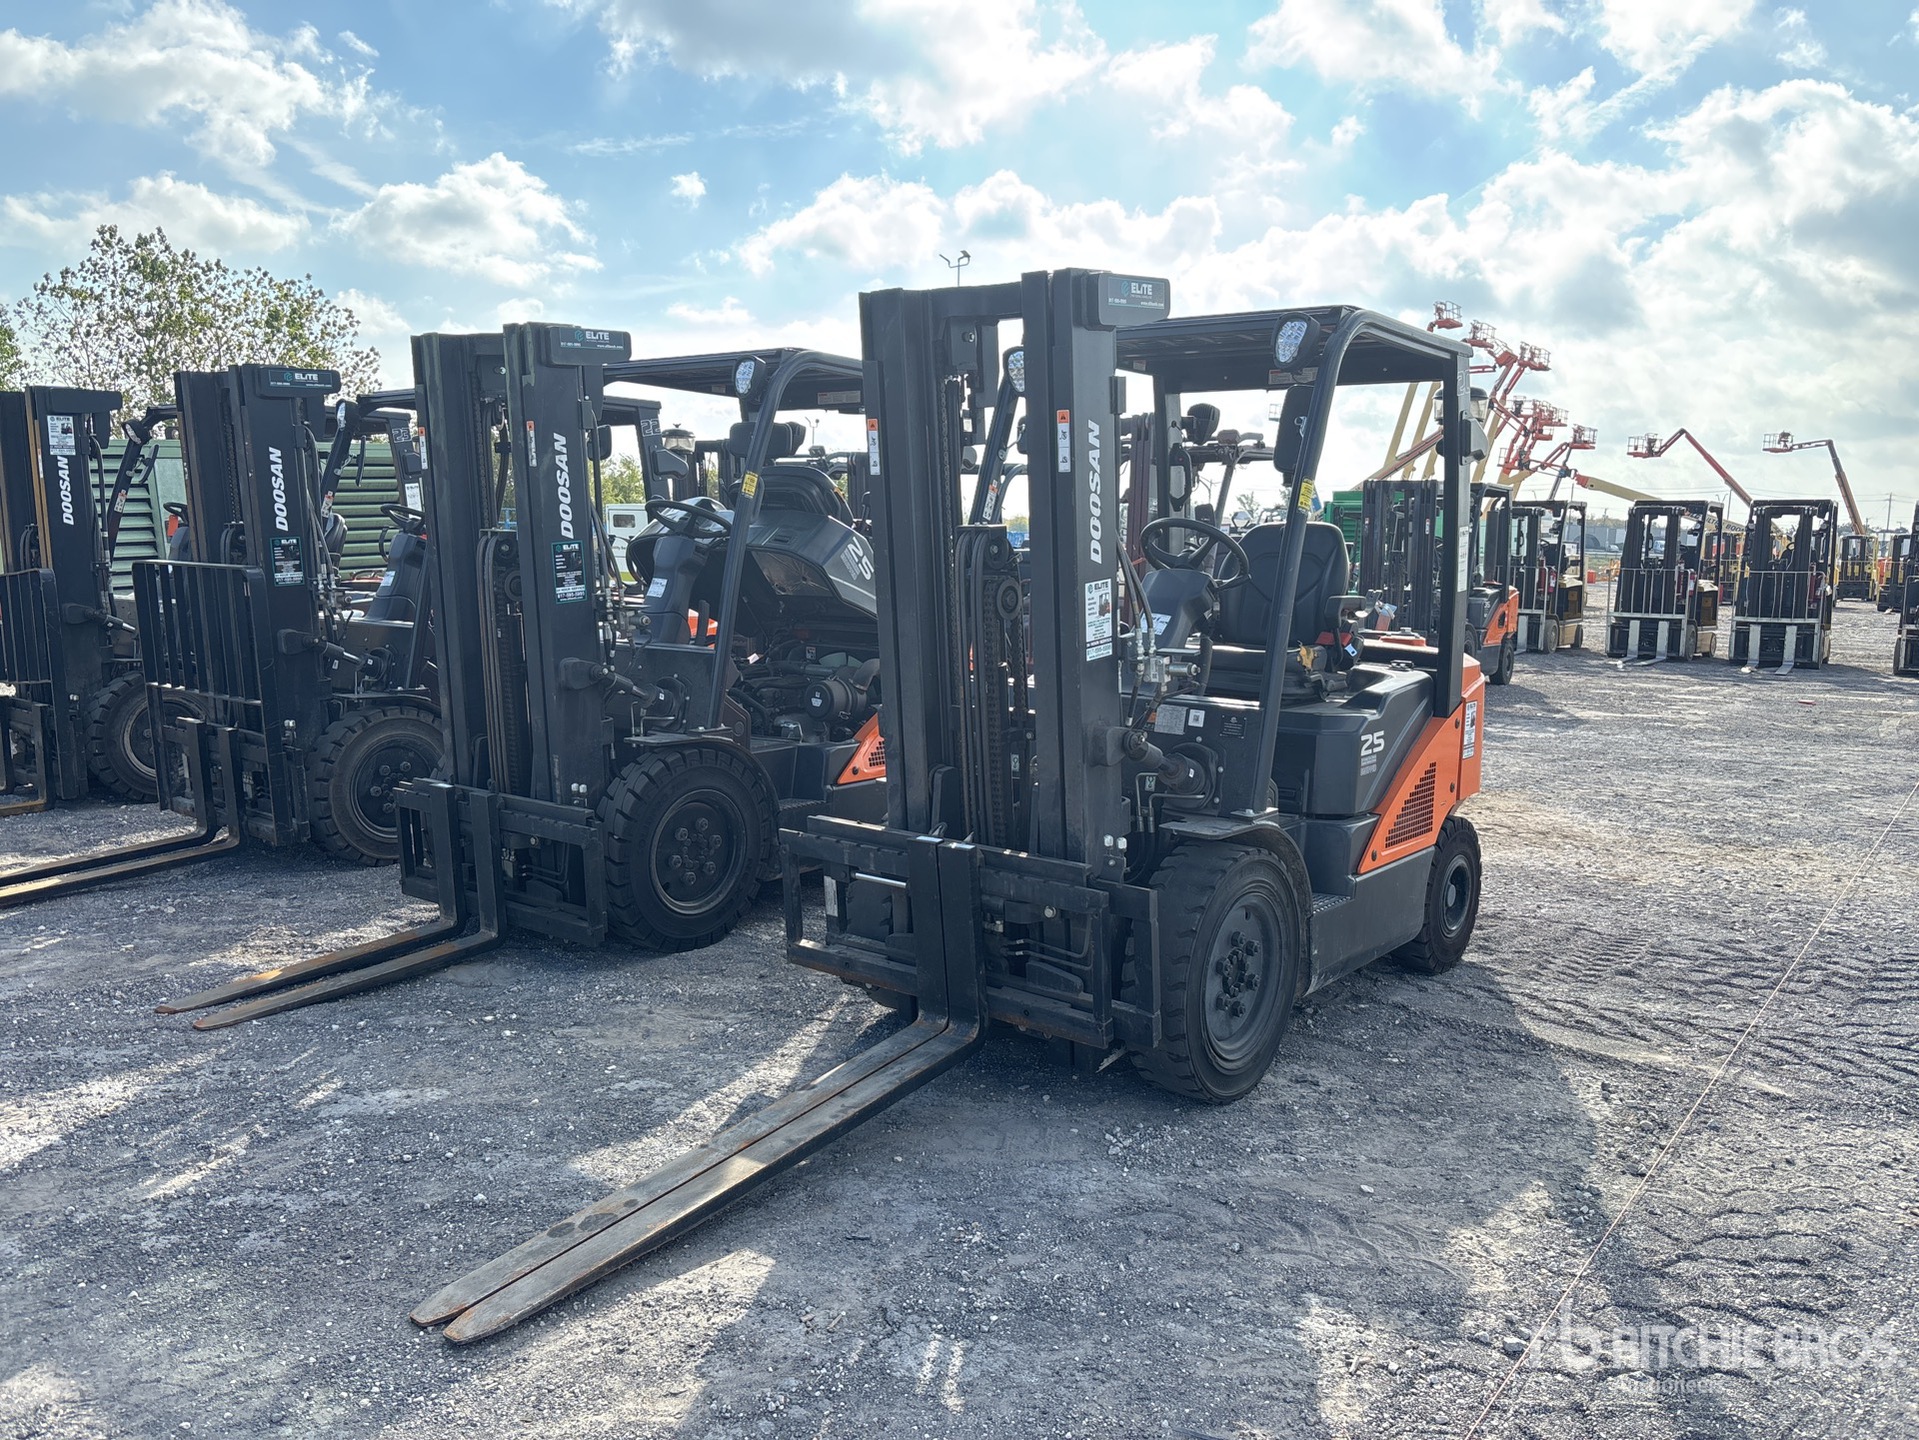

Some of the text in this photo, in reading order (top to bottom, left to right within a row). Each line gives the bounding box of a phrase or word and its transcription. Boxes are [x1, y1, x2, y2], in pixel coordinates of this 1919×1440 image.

[1131, 282, 1152, 295] ELITE
[585, 331, 610, 341] ELITE
[640, 418, 661, 437] 22
[56, 456, 75, 525] DOOSAN
[268, 446, 289, 531] DOOSAN
[553, 432, 574, 539] DOOSAN
[1088, 419, 1102, 564] DOOSAN
[847, 536, 875, 580] 25
[1360, 730, 1385, 756] 25
